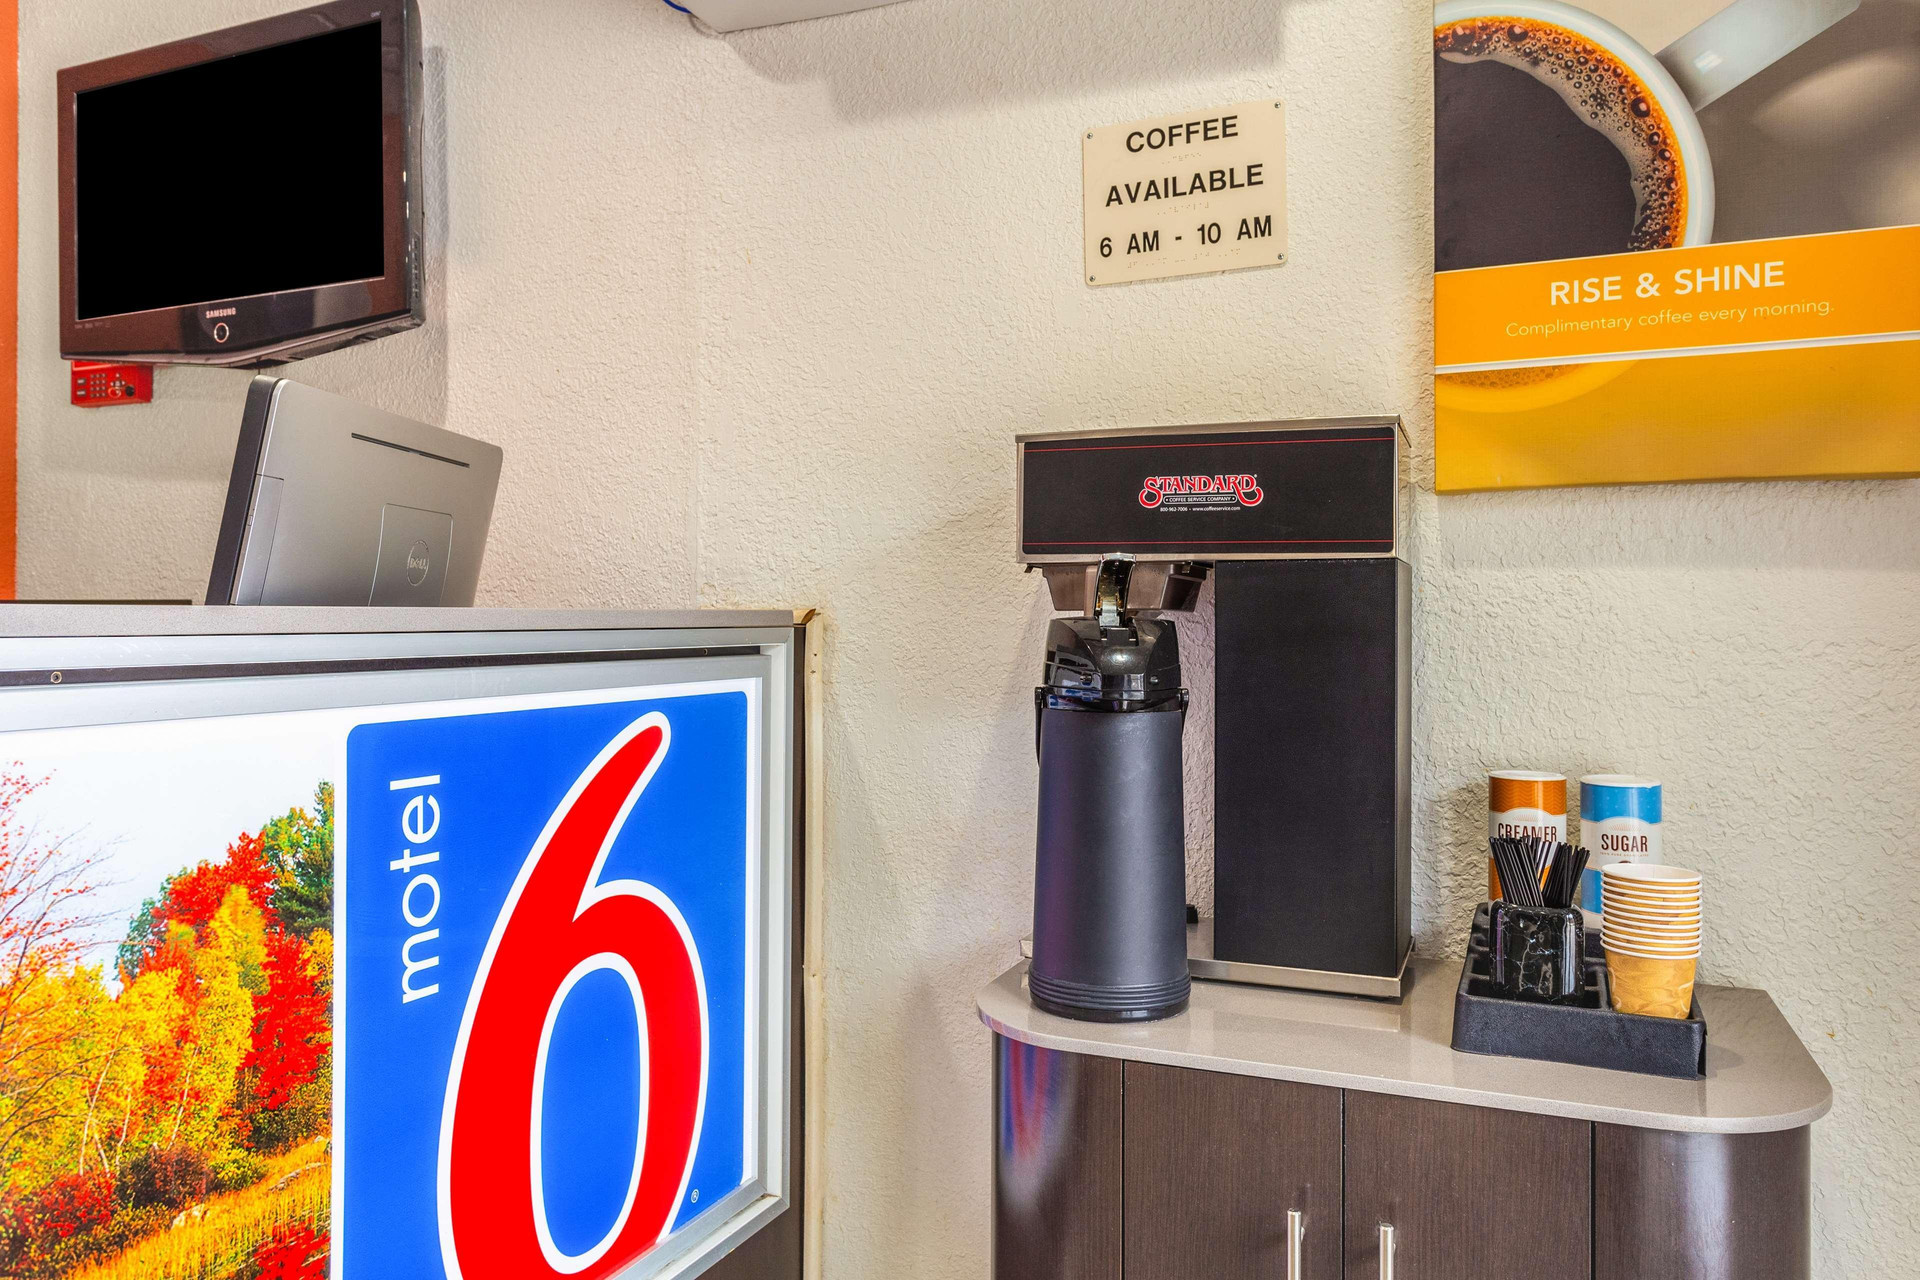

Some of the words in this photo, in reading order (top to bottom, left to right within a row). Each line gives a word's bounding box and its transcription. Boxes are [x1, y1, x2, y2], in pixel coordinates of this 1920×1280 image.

[1126, 115, 1239, 153] COFFEE
[1105, 163, 1264, 207] AVAILABLE
[1099, 236, 1113, 258] 6
[1126, 230, 1160, 255] AM
[1197, 222, 1221, 245] 10
[1237, 215, 1272, 241] AM
[1550, 275, 1622, 305] RISE
[1635, 272, 1661, 299] &
[1674, 260, 1785, 295] SHINE
[205, 307, 236, 319] SAMSUNG
[1505, 316, 1632, 338] Complimentary
[1638, 309, 1693, 326] coffee
[1698, 308, 1747, 324] every
[1753, 299, 1835, 318] morning.
[1138, 474, 1264, 508] STANDARD
[1498, 822, 1557, 842] CREAMER
[1601, 833, 1648, 852] SUGAR
[389, 773, 441, 1005] motel
[437, 711, 710, 1280] 6
